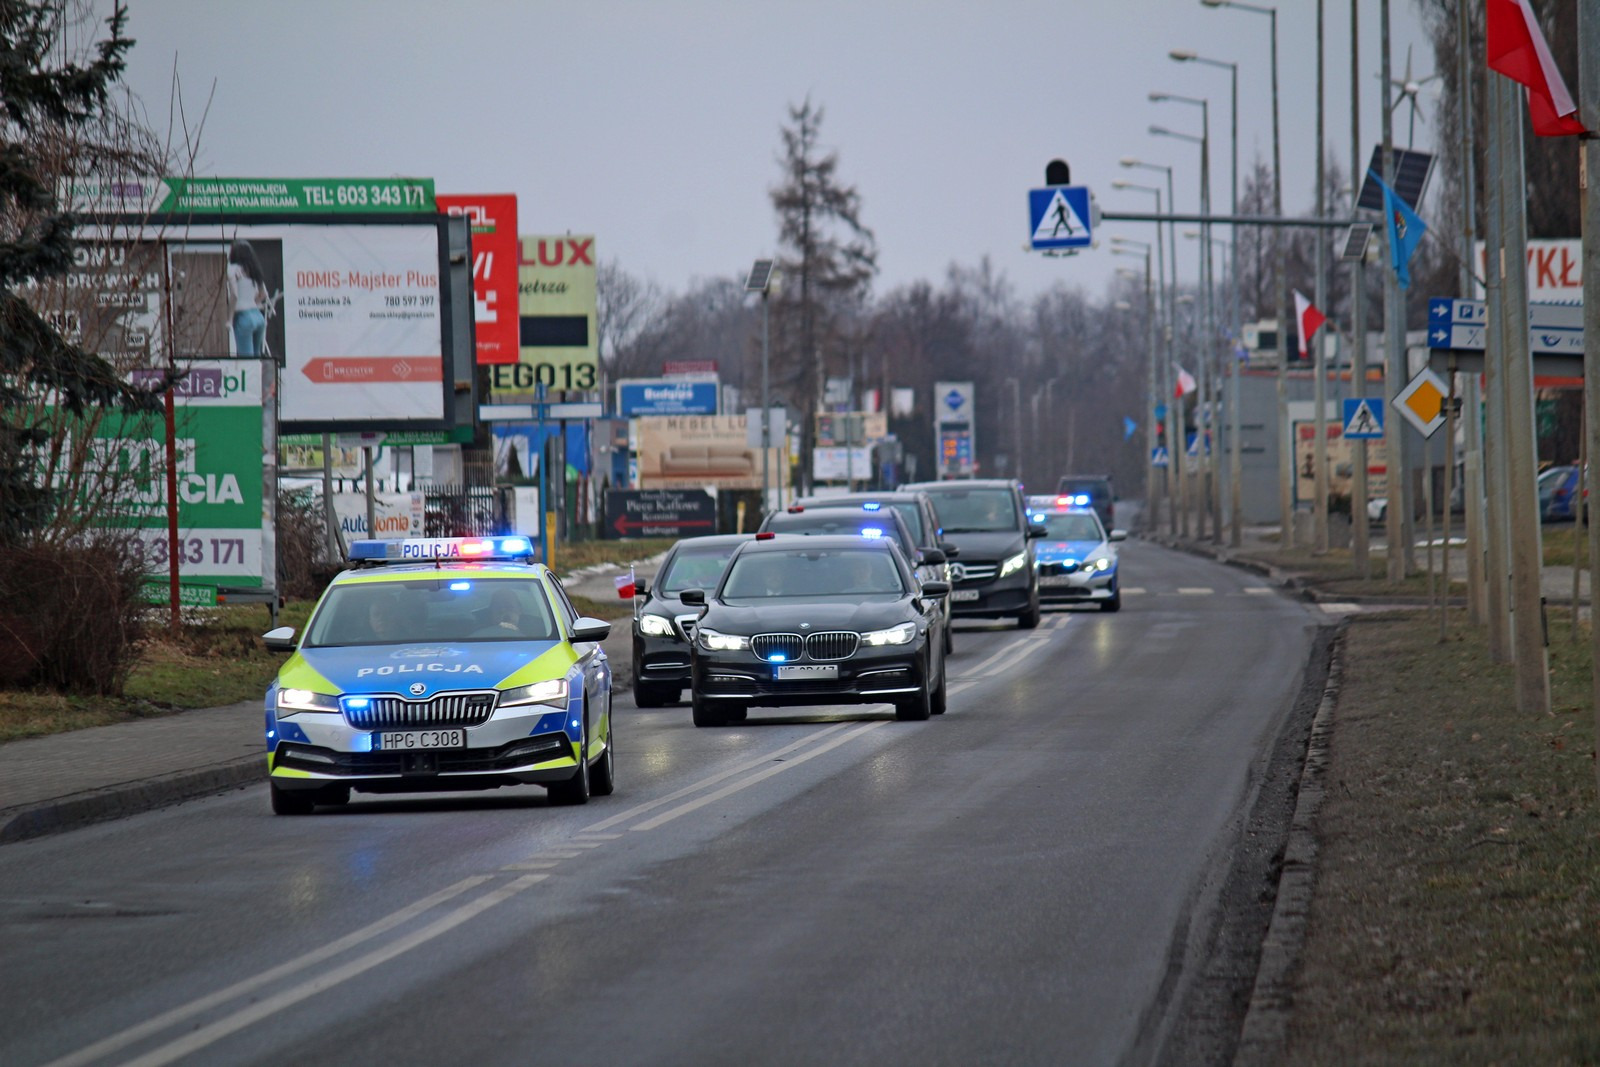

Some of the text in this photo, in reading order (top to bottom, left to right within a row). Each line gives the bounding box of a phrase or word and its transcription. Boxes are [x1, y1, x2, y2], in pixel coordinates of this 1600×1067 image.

[187, 184, 288, 196] REKLAMA DO WYNAJĘCIA
[303, 185, 425, 205] TEL: 603 343 171
[230, 196, 259, 207] TWOJA
[261, 196, 299, 208] REKLAMA
[407, 270, 437, 289] Plus
[518, 279, 569, 295] nętrza
[384, 296, 434, 306] 780 597 397
[299, 309, 333, 320] Oświęcim
[489, 363, 596, 389] EGO 13
[141, 370, 246, 398] mdia.pl
[728, 418, 747, 429] LU
[152, 539, 203, 564] 33
[210, 539, 244, 564] 171
[403, 544, 460, 558] POLICJA
[357, 663, 484, 677] POLICJA
[384, 731, 460, 749] HPG C308
